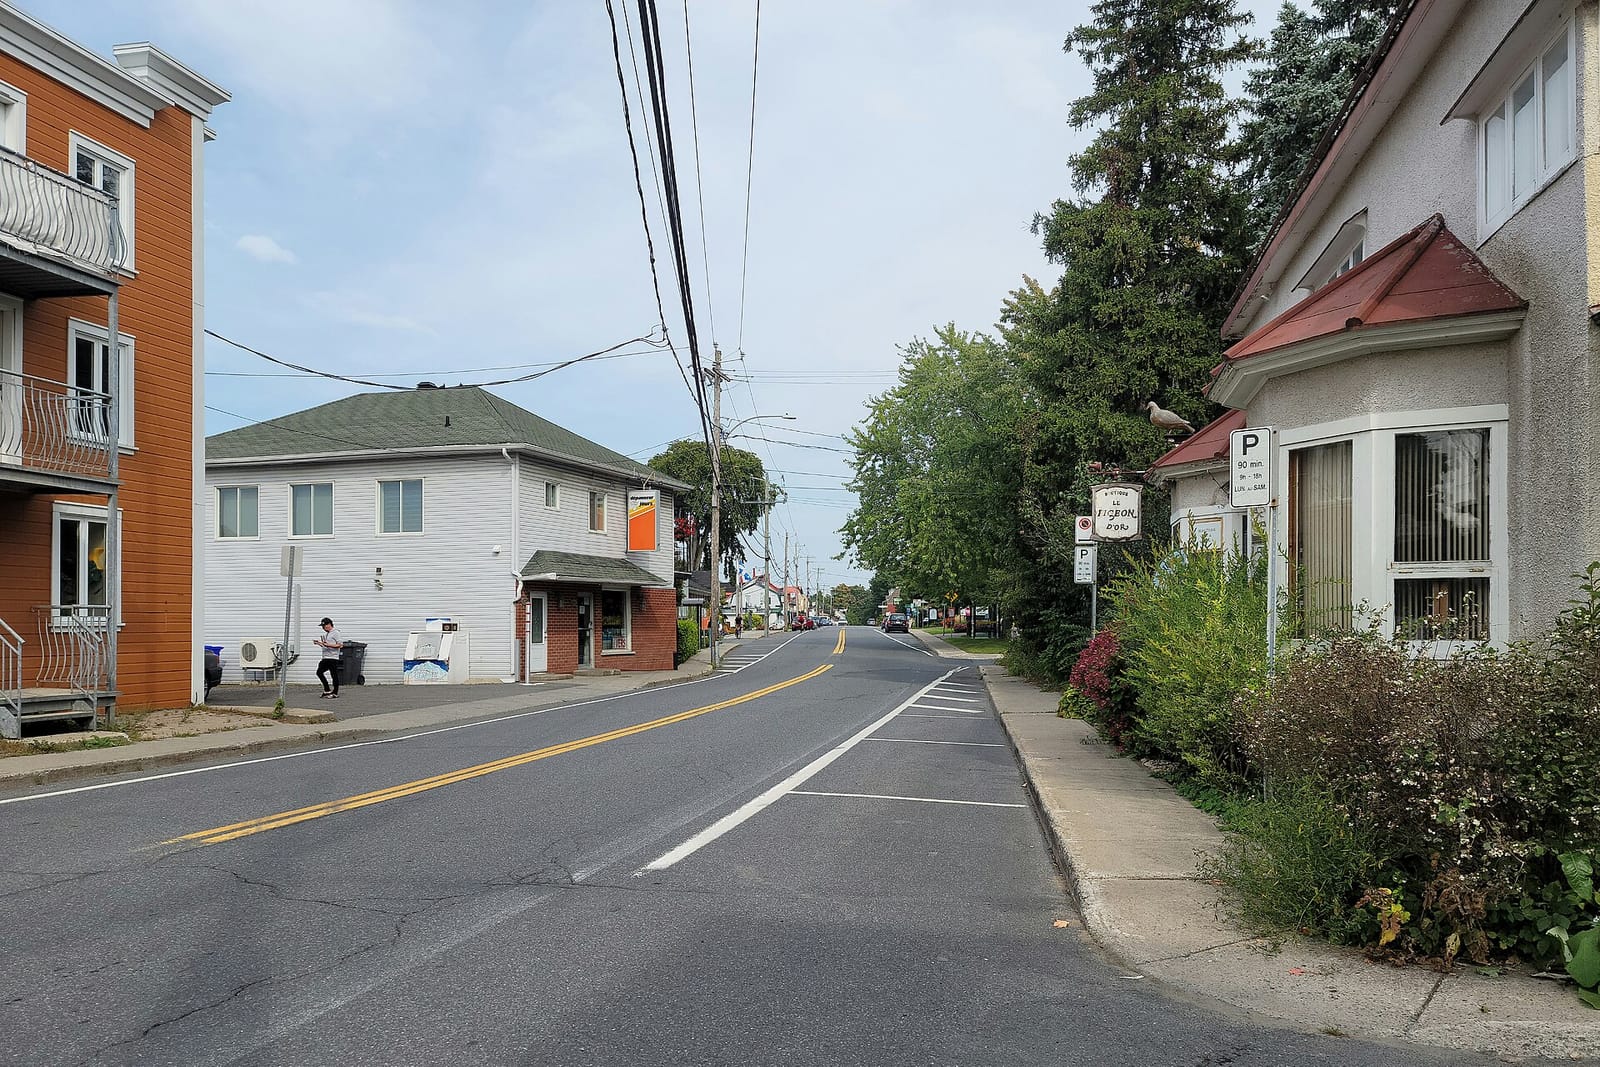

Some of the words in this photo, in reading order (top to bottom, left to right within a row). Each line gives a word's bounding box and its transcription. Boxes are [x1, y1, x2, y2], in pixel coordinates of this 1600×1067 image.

[1243, 434, 1259, 455] P
[1238, 461, 1247, 469] 90
[1250, 460, 1264, 468] min.
[1080, 549, 1088, 559] P
